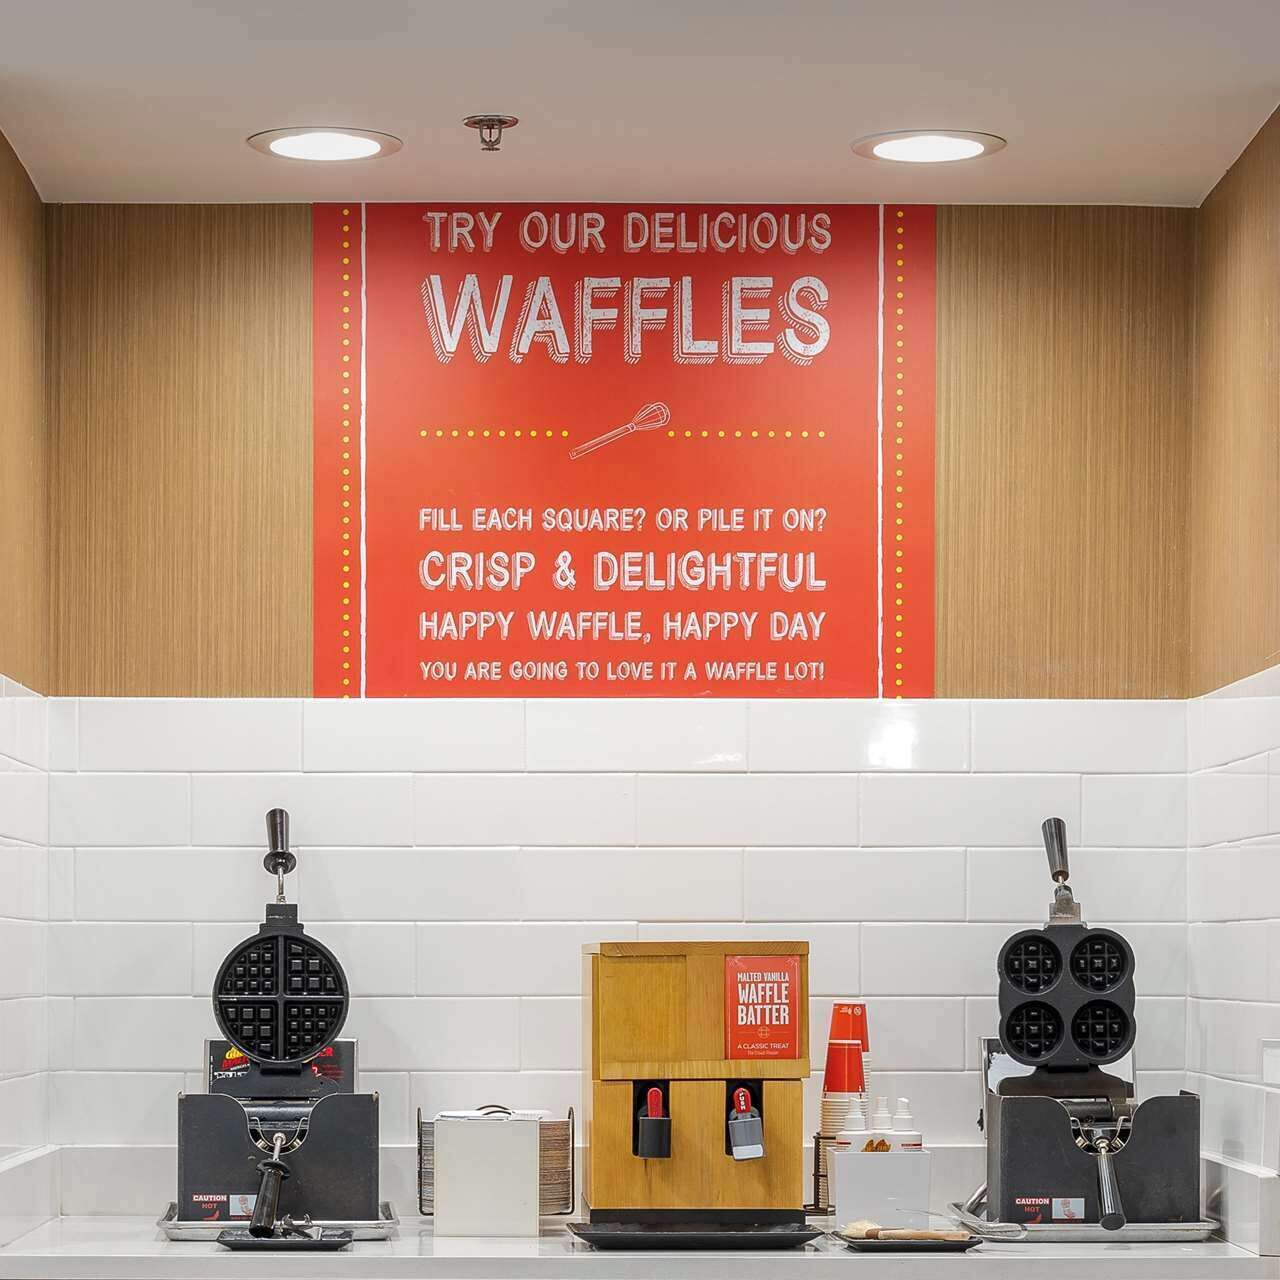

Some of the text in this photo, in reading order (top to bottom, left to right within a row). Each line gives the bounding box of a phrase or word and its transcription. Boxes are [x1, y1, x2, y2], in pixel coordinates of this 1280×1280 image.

[423, 211, 833, 254] TRY OUR DELICIOUS
[421, 273, 832, 366] WAFFLES
[419, 507, 828, 533] FILL EACH SQUARE? OR PILE IT ON?
[418, 550, 828, 592] CRISP & DELIGHTFUL
[419, 611, 828, 645] HAPPY WAFFLE, HAPPY DAY
[419, 661, 825, 682] YOU ARE GOING TO LOVE IT A WAFFLE LOT!
[737, 972, 790, 982] MALTED VANILLA
[738, 983, 790, 1003] WAFFLE
[738, 1005, 790, 1025] BATTER
[743, 1042, 769, 1050] CLASSIC
